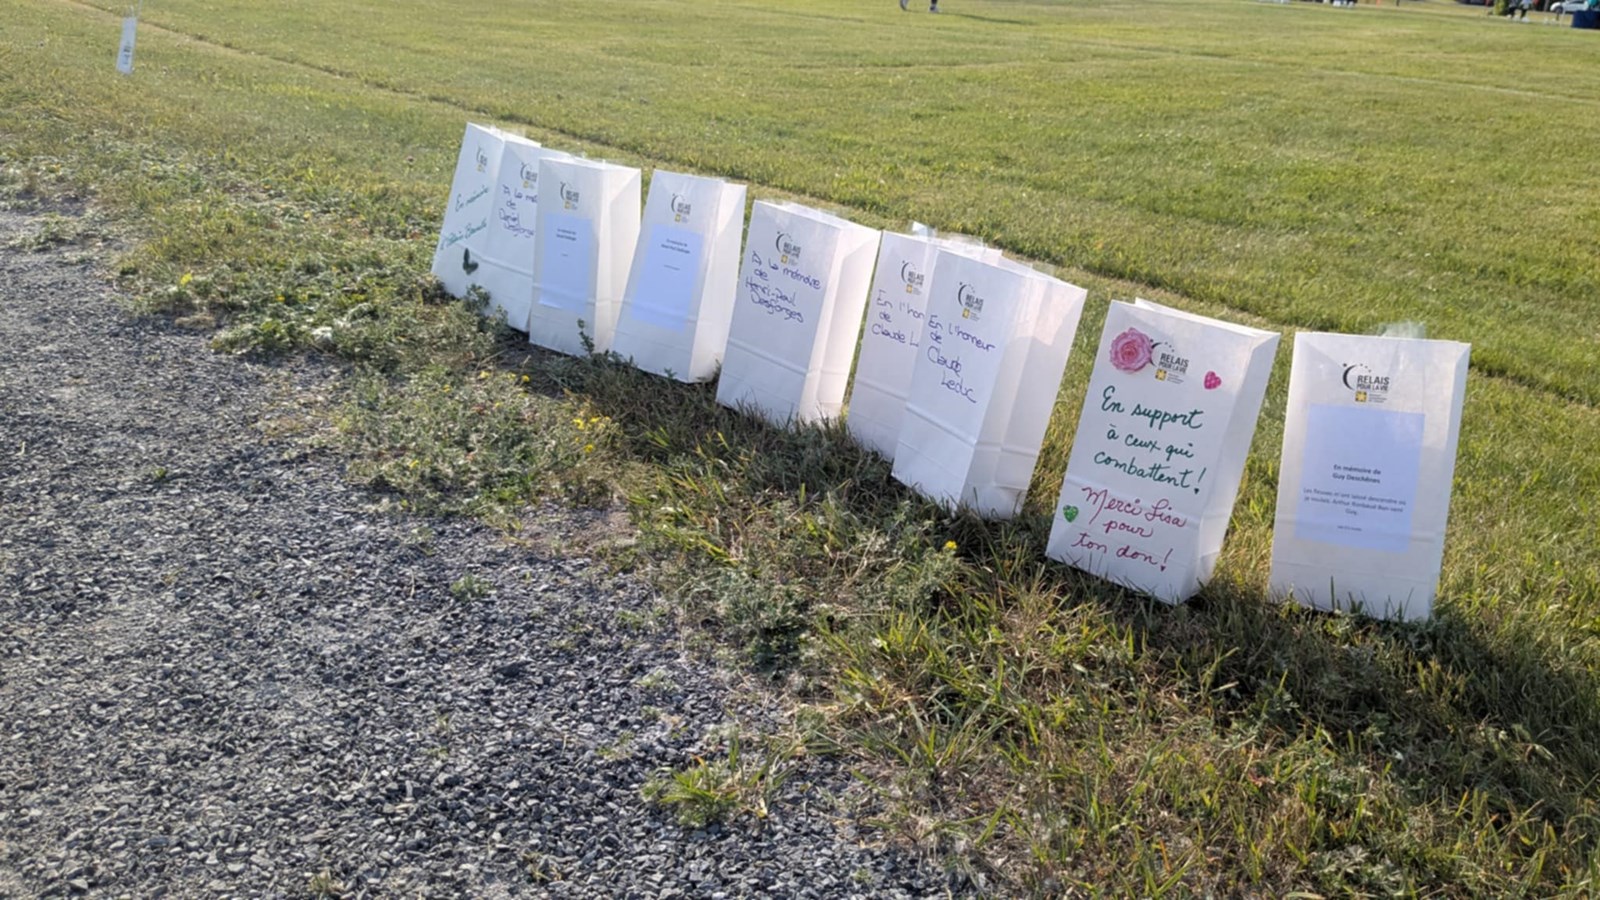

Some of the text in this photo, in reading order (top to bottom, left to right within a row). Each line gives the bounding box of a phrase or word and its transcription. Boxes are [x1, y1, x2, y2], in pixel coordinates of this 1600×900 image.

[754, 268, 769, 281] de
[876, 289, 893, 308] En
[879, 311, 892, 323] de
[928, 314, 943, 330] En
[930, 329, 942, 344] de
[1160, 352, 1190, 368] RELAIS
[941, 370, 977, 404] Leduc
[1356, 374, 1390, 386] RELAIS
[1101, 385, 1204, 430] En support
[1107, 423, 1194, 461] à ceux qui
[1332, 472, 1345, 480] Guy
[1343, 465, 1371, 474] mémoire
[1082, 487, 1187, 527] Merci Lisa
[1103, 520, 1154, 538] pour
[1071, 532, 1107, 554] ton
